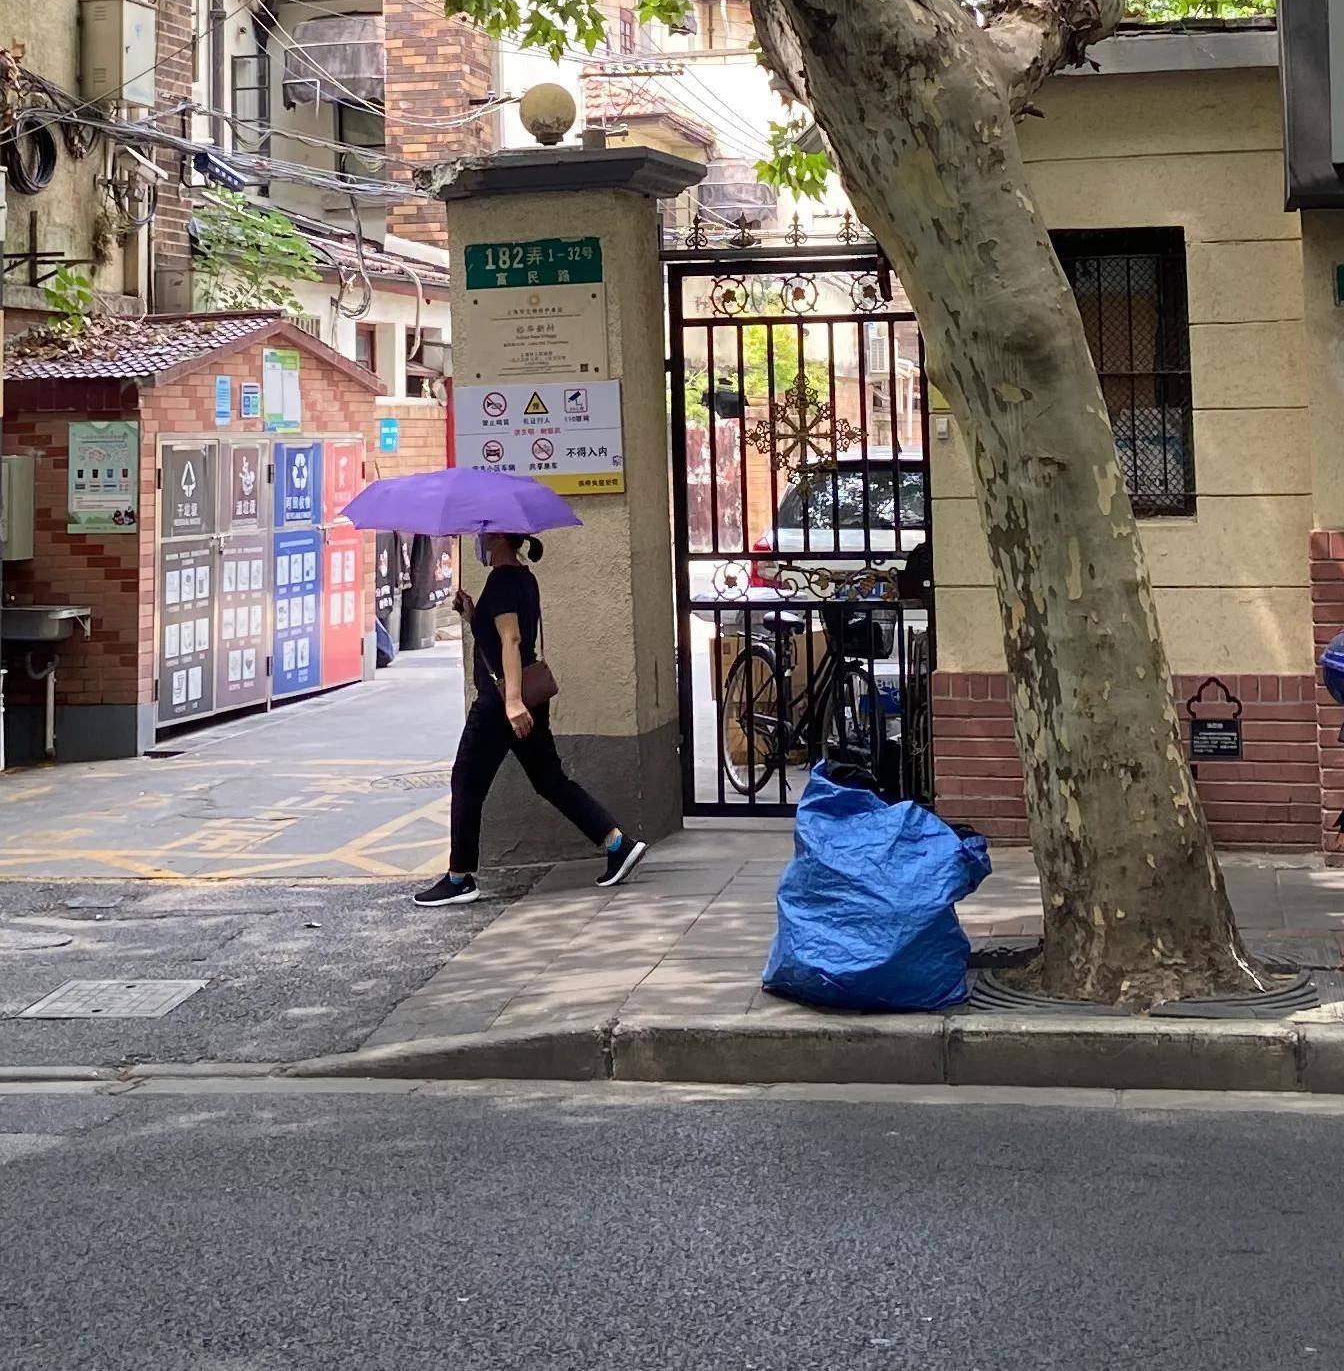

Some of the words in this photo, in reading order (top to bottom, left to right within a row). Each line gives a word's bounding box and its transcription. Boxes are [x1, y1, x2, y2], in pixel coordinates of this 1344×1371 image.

[485, 246, 544, 270] 182弄
[496, 269, 571, 286] 富民路
[566, 446, 608, 458] 不得入内
